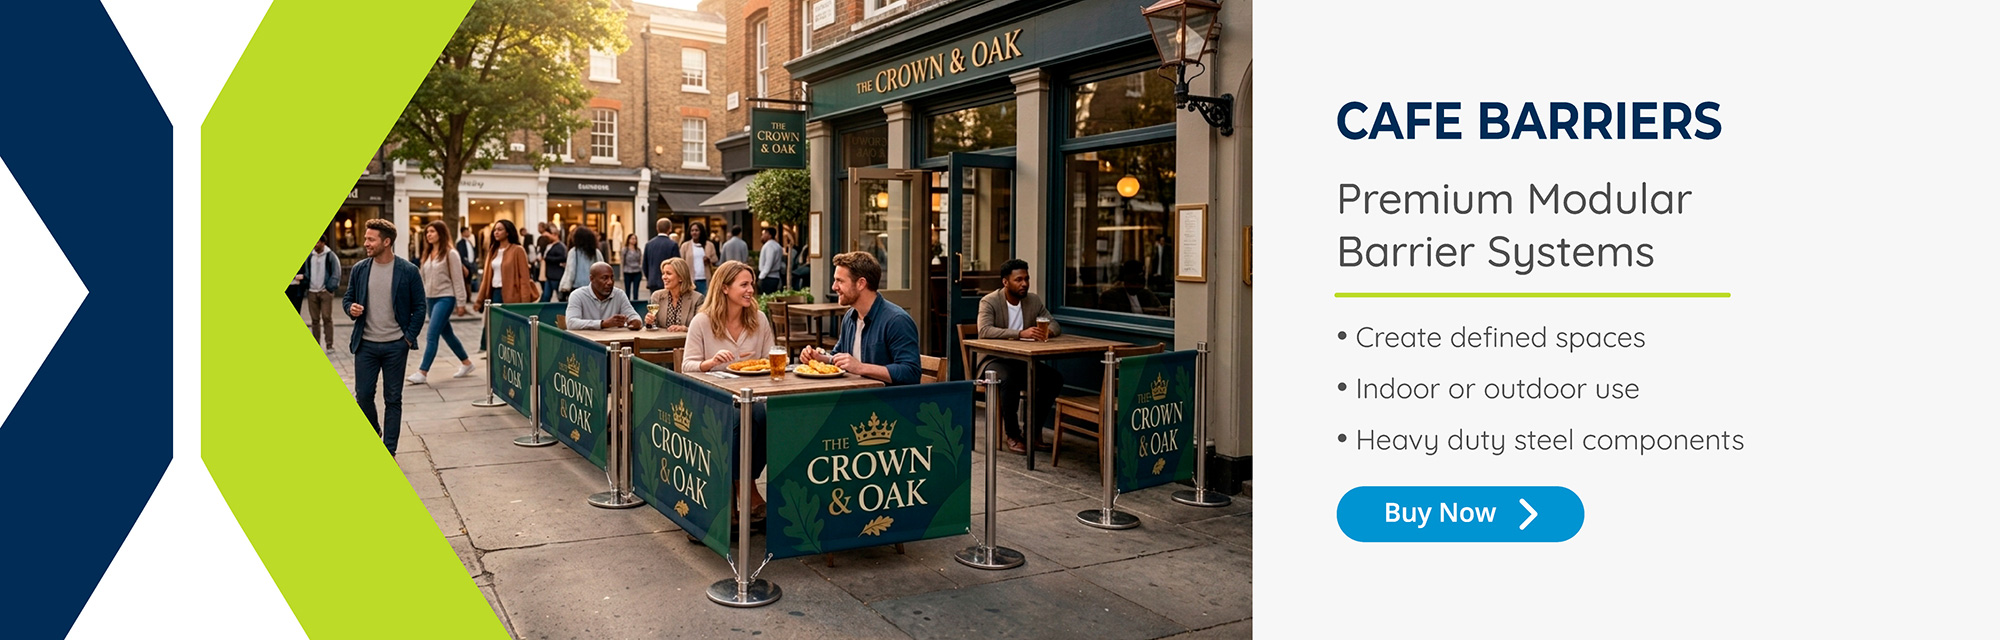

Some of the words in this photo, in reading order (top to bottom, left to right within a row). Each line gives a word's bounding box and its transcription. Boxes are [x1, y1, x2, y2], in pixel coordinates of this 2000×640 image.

[856, 80, 873, 94] THE
[875, 53, 945, 93] CROWN
[949, 48, 966, 74] &
[971, 28, 1024, 67] OAK
[757, 130, 800, 142] CROWN
[771, 122, 786, 130] THE
[760, 143, 769, 153] &
[772, 144, 796, 154] OAK
[554, 372, 593, 408] CROWN
[569, 403, 592, 433] OAK
[1131, 401, 1183, 431] CROWN
[652, 423, 711, 477] CROWN
[822, 438, 850, 451] THE
[1139, 435, 1148, 457] &
[1151, 429, 1178, 455] OAK
[807, 445, 933, 485] CROWN
[660, 458, 670, 485] &
[673, 466, 707, 509] OAK
[828, 487, 852, 516] &
[858, 478, 928, 512] OAK
